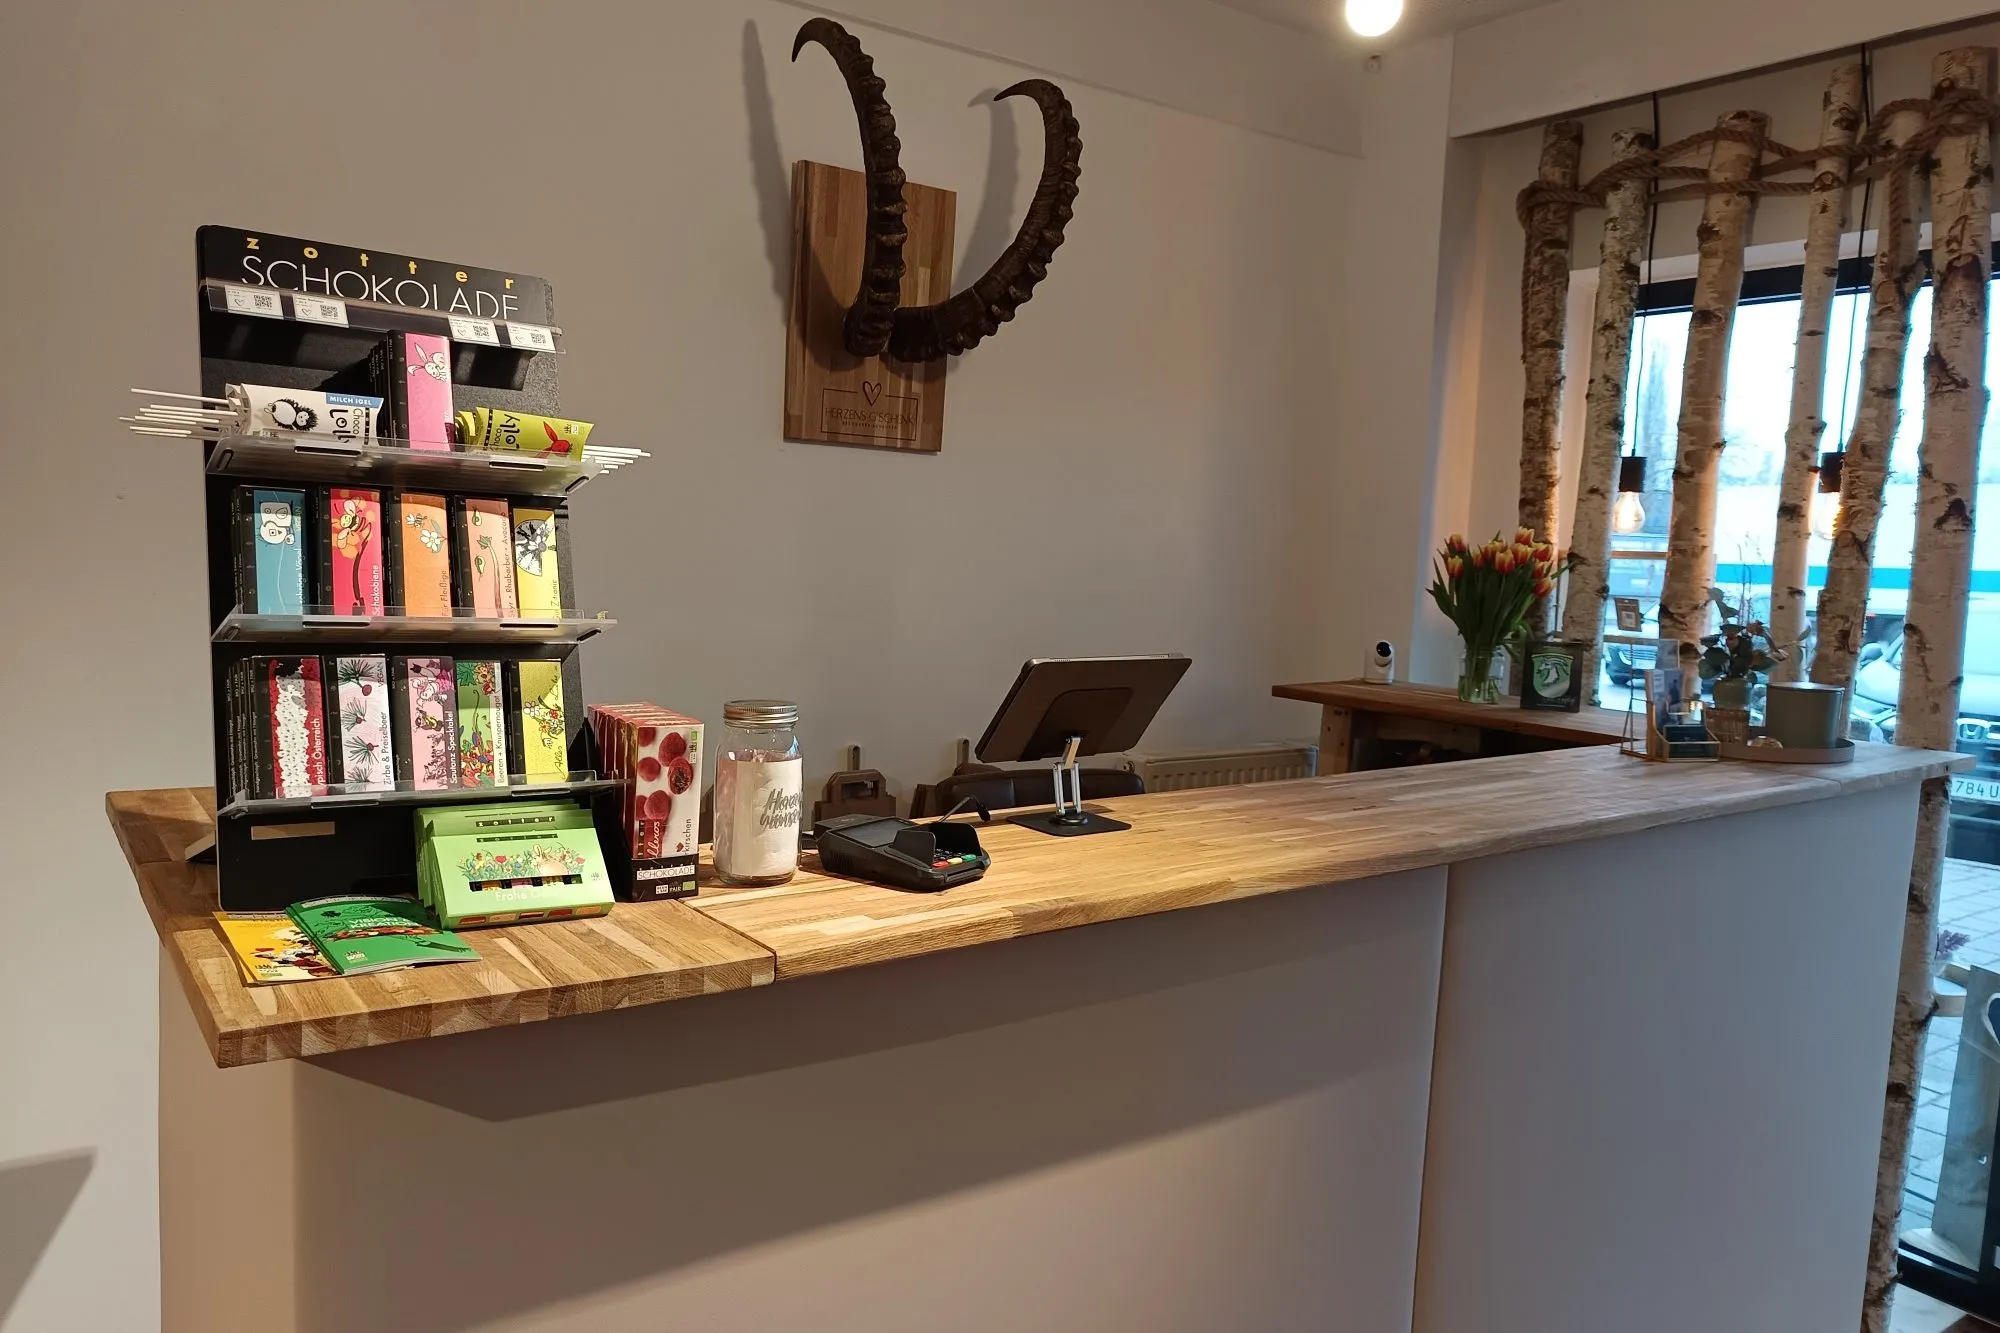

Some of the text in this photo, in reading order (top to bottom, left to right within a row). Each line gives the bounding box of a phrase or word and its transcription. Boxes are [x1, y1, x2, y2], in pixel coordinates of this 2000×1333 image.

[246, 237, 514, 289] zotter
[242, 255, 518, 320] SCHOKOLADE
[329, 396, 372, 406] MILCH IGEL
[353, 408, 365, 435] Choco
[500, 413, 521, 451] Lolly
[489, 428, 503, 451] Choco
[501, 511, 509, 545] Avocado
[370, 564, 380, 616] Schokobiene
[439, 569, 449, 602] Fleißige
[504, 553, 513, 593] Rhabarber
[446, 711, 455, 751] Specktakel
[495, 694, 503, 750] Knuspernougat
[310, 718, 327, 792] ypisch Österreich
[380, 711, 392, 785] Zirbe & Preiselbeer
[554, 746, 566, 780] Alles
[497, 757, 505, 784] Beeren
[1956, 780, 1985, 797] 784
[478, 816, 555, 828] zotter
[646, 820, 660, 858] lleros
[637, 866, 694, 880] SCHOKOLADE
[495, 890, 528, 902] Frohe
